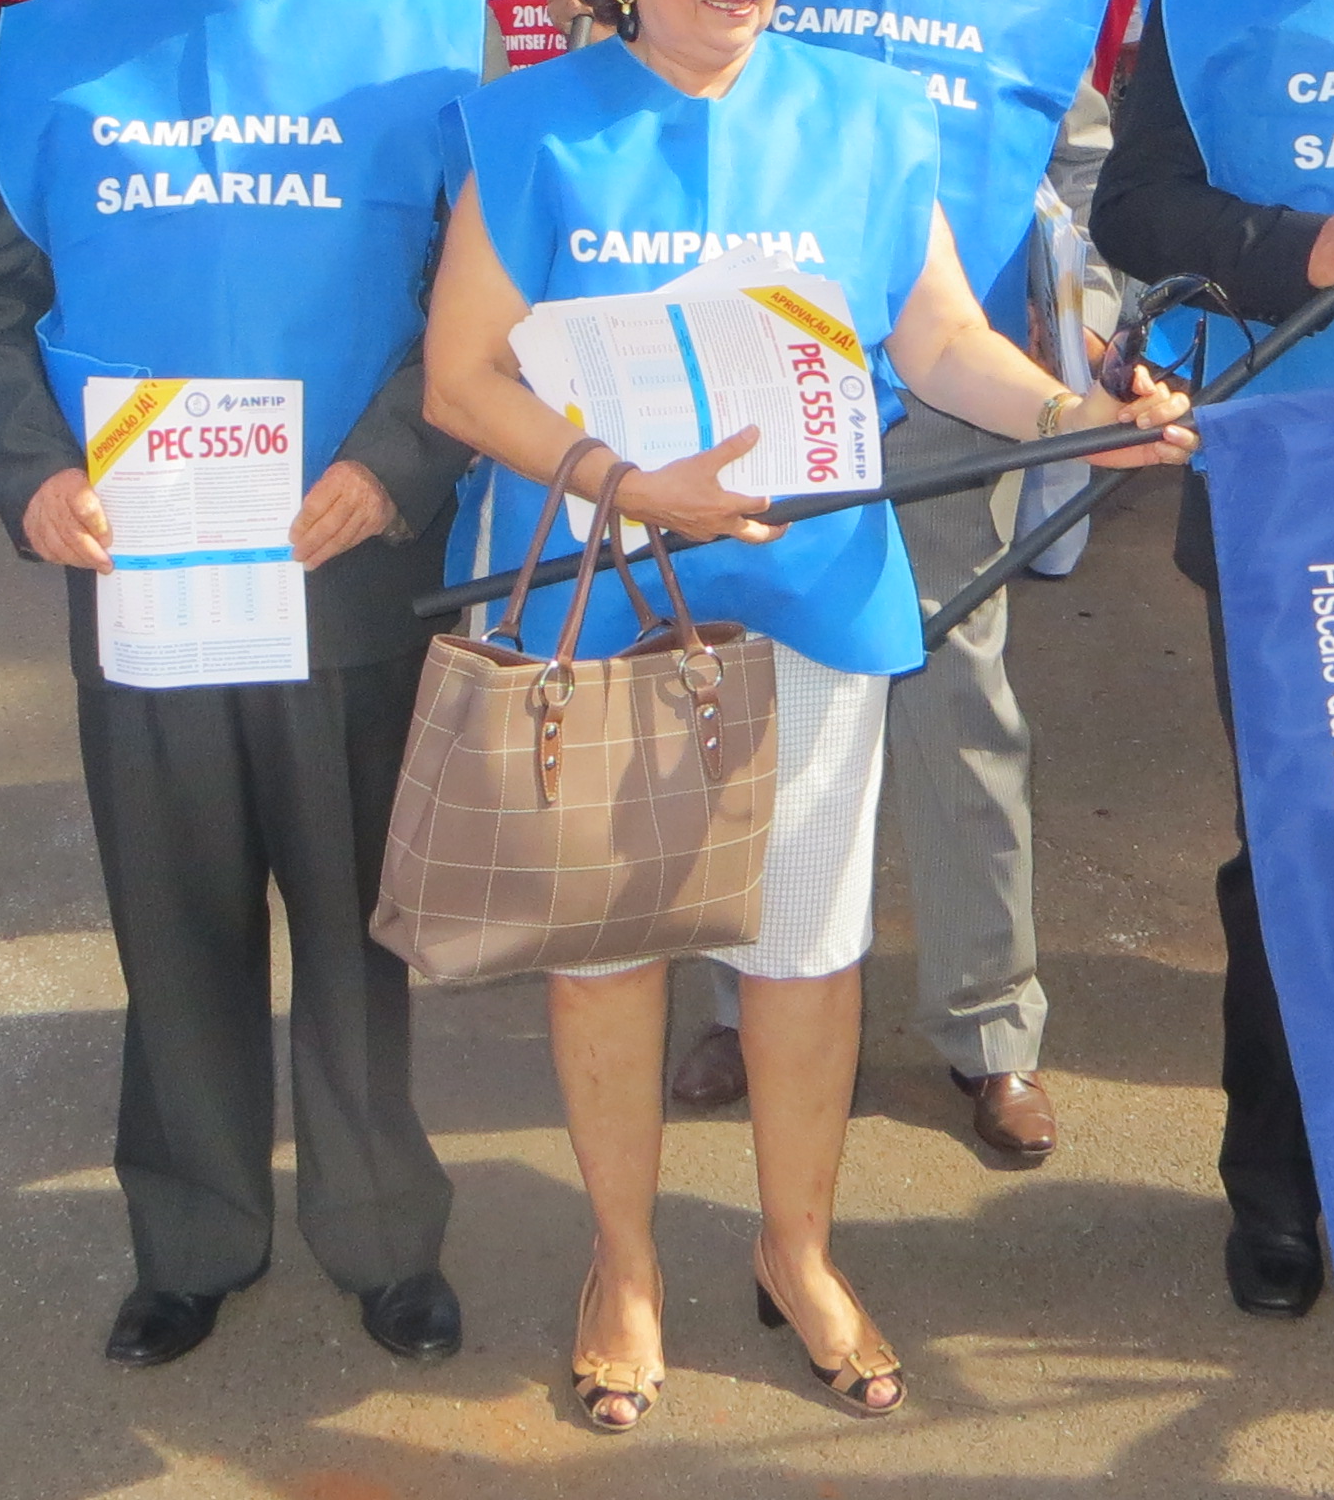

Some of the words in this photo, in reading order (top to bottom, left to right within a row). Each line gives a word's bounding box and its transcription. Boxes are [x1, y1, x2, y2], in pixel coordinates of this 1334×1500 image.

[771, 5, 984, 53] CAMPANHA
[92, 114, 344, 147] CAMPANHA
[95, 171, 343, 215] SALARIAL
[770, 291, 831, 336] APROVAÇÃO
[829, 329, 856, 351] JÁ!
[787, 342, 830, 386] PEC
[240, 395, 286, 409] ANFIP
[92, 414, 139, 462] APROVAÇÃO
[137, 392, 159, 419] JÁ!
[147, 425, 193, 462] PEC
[199, 422, 289, 460] 555/06
[799, 390, 839, 483] 555/06
[853, 430, 867, 480] ANFIP
